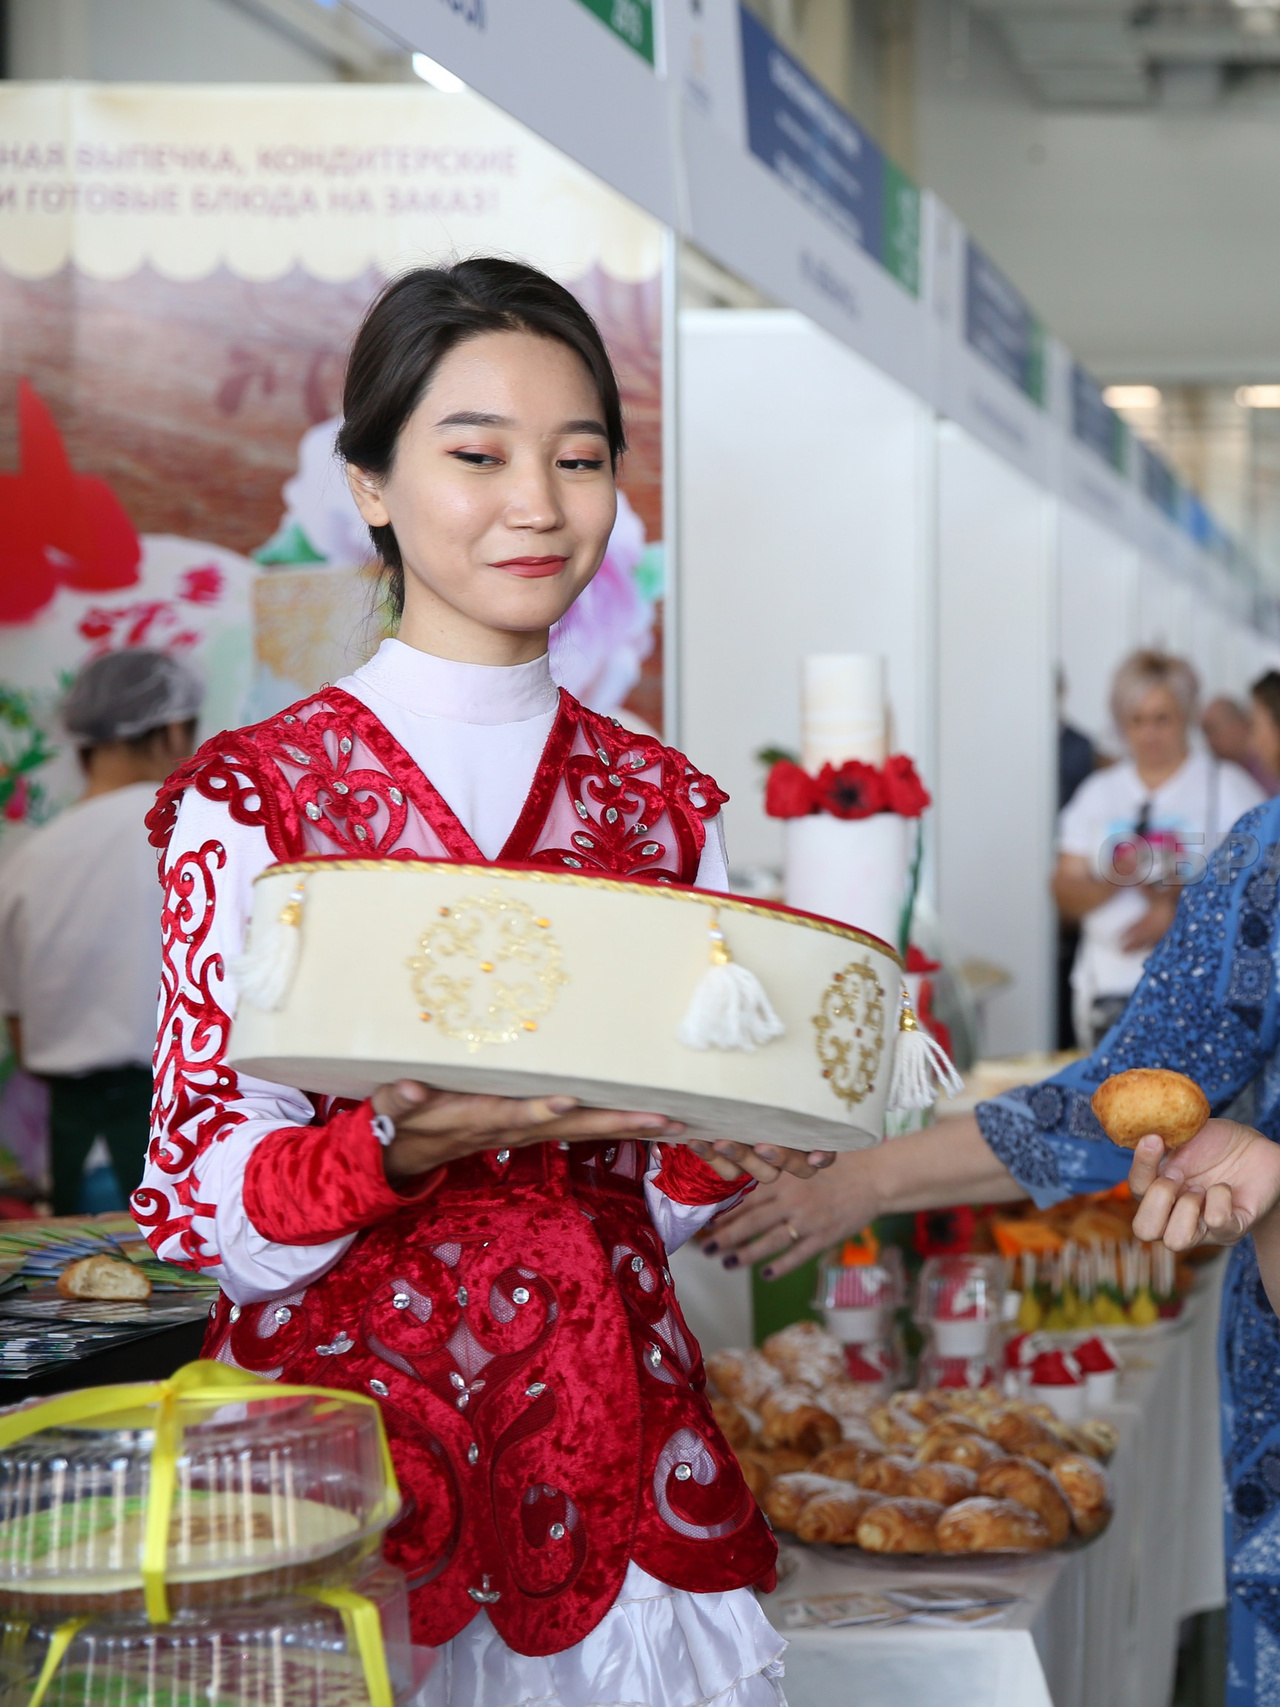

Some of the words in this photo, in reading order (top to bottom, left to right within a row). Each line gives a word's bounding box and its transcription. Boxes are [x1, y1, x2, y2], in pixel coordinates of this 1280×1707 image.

[75, 142, 247, 176] ВЫПЕЧКА,
[256, 142, 517, 177] КОНДИТЕРСКИЕ
[26, 184, 179, 214] ГОТОВЫЕ
[191, 184, 317, 218] БЛЮДА
[328, 184, 375, 214] НА
